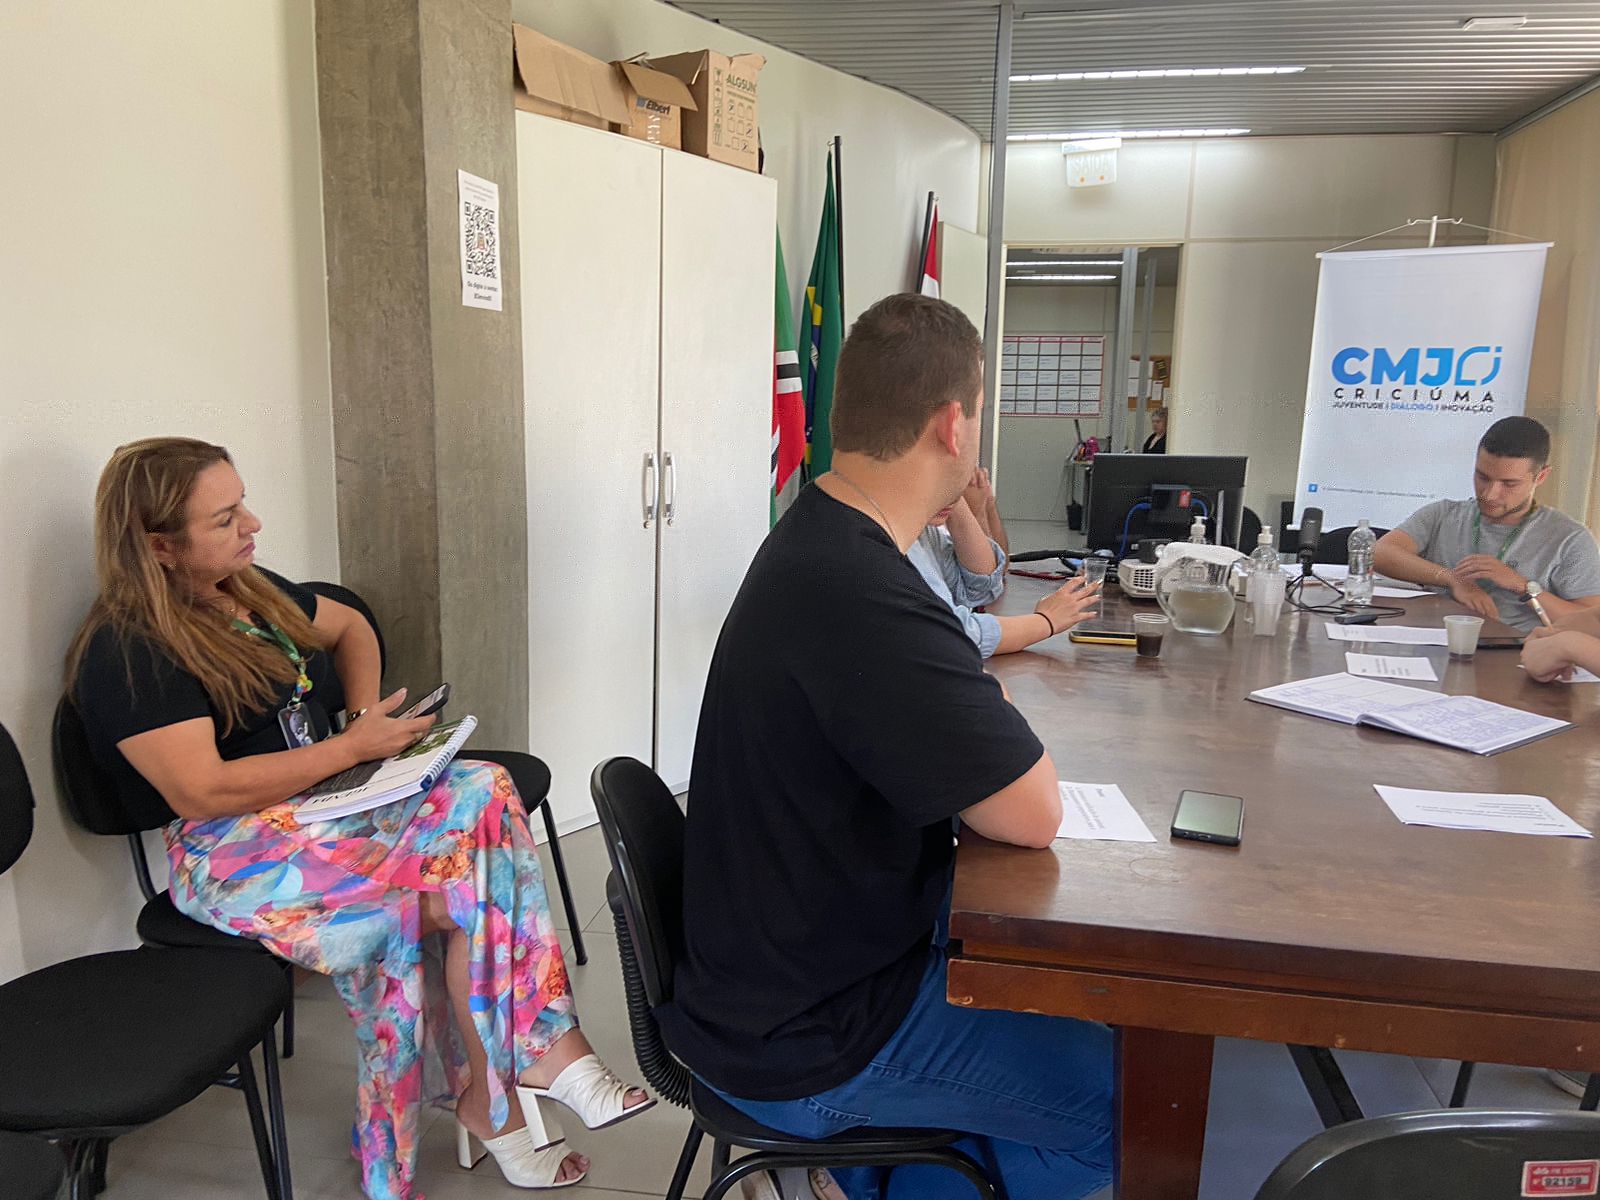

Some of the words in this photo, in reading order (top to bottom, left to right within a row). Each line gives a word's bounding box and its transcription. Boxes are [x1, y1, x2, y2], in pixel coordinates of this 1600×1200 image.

[1334, 387, 1494, 402] CRICIÚMA
[1332, 402, 1384, 410] JUVENTUDE
[1440, 403, 1494, 414] INOVAÇÃO
